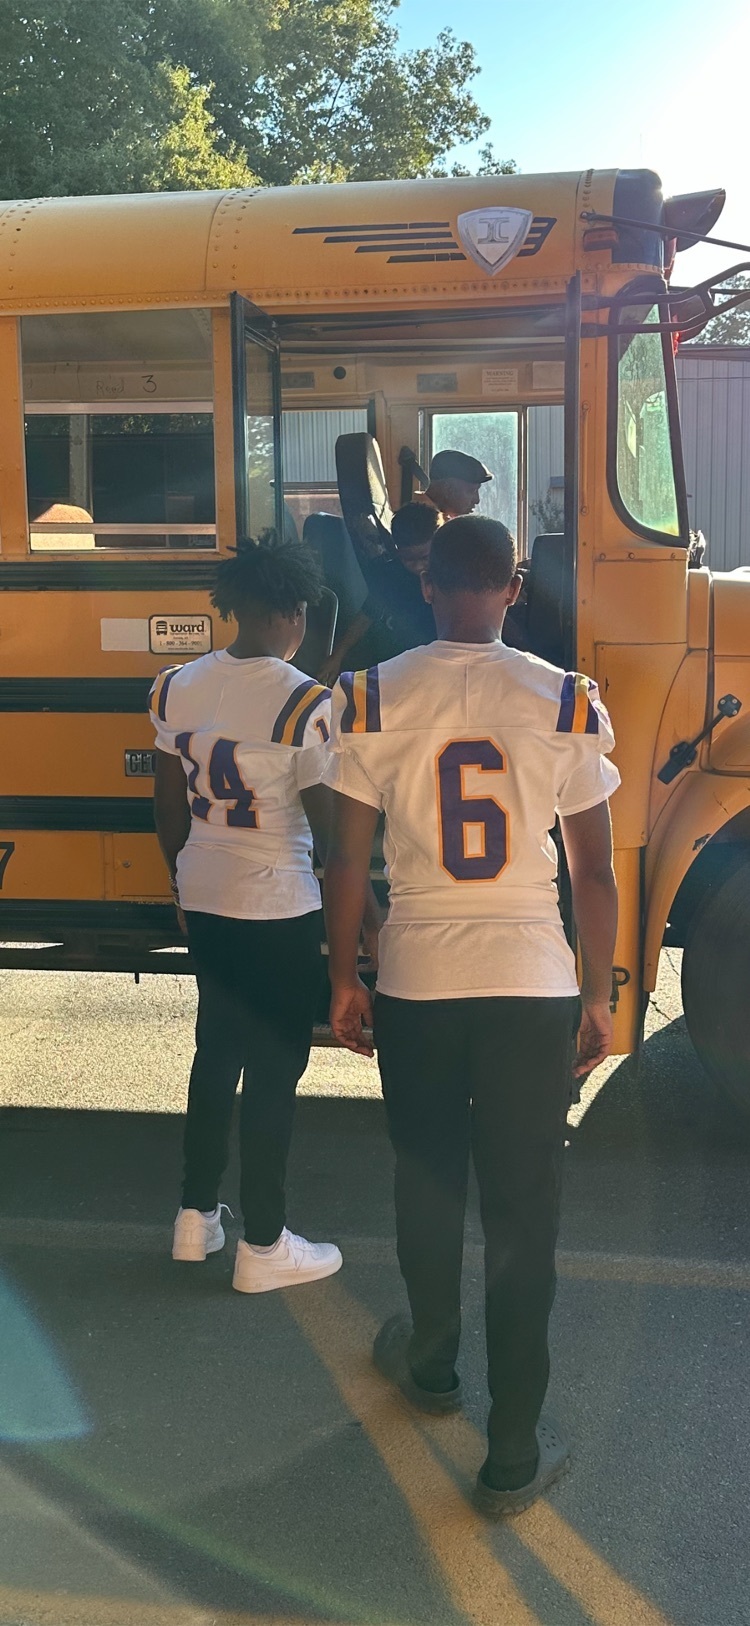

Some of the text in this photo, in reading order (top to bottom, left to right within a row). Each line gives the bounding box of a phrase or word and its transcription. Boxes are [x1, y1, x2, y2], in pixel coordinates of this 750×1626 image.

[141, 374, 157, 393] 3
[169, 620, 205, 633] ward
[174, 731, 261, 829] 14
[434, 736, 511, 884] 6
